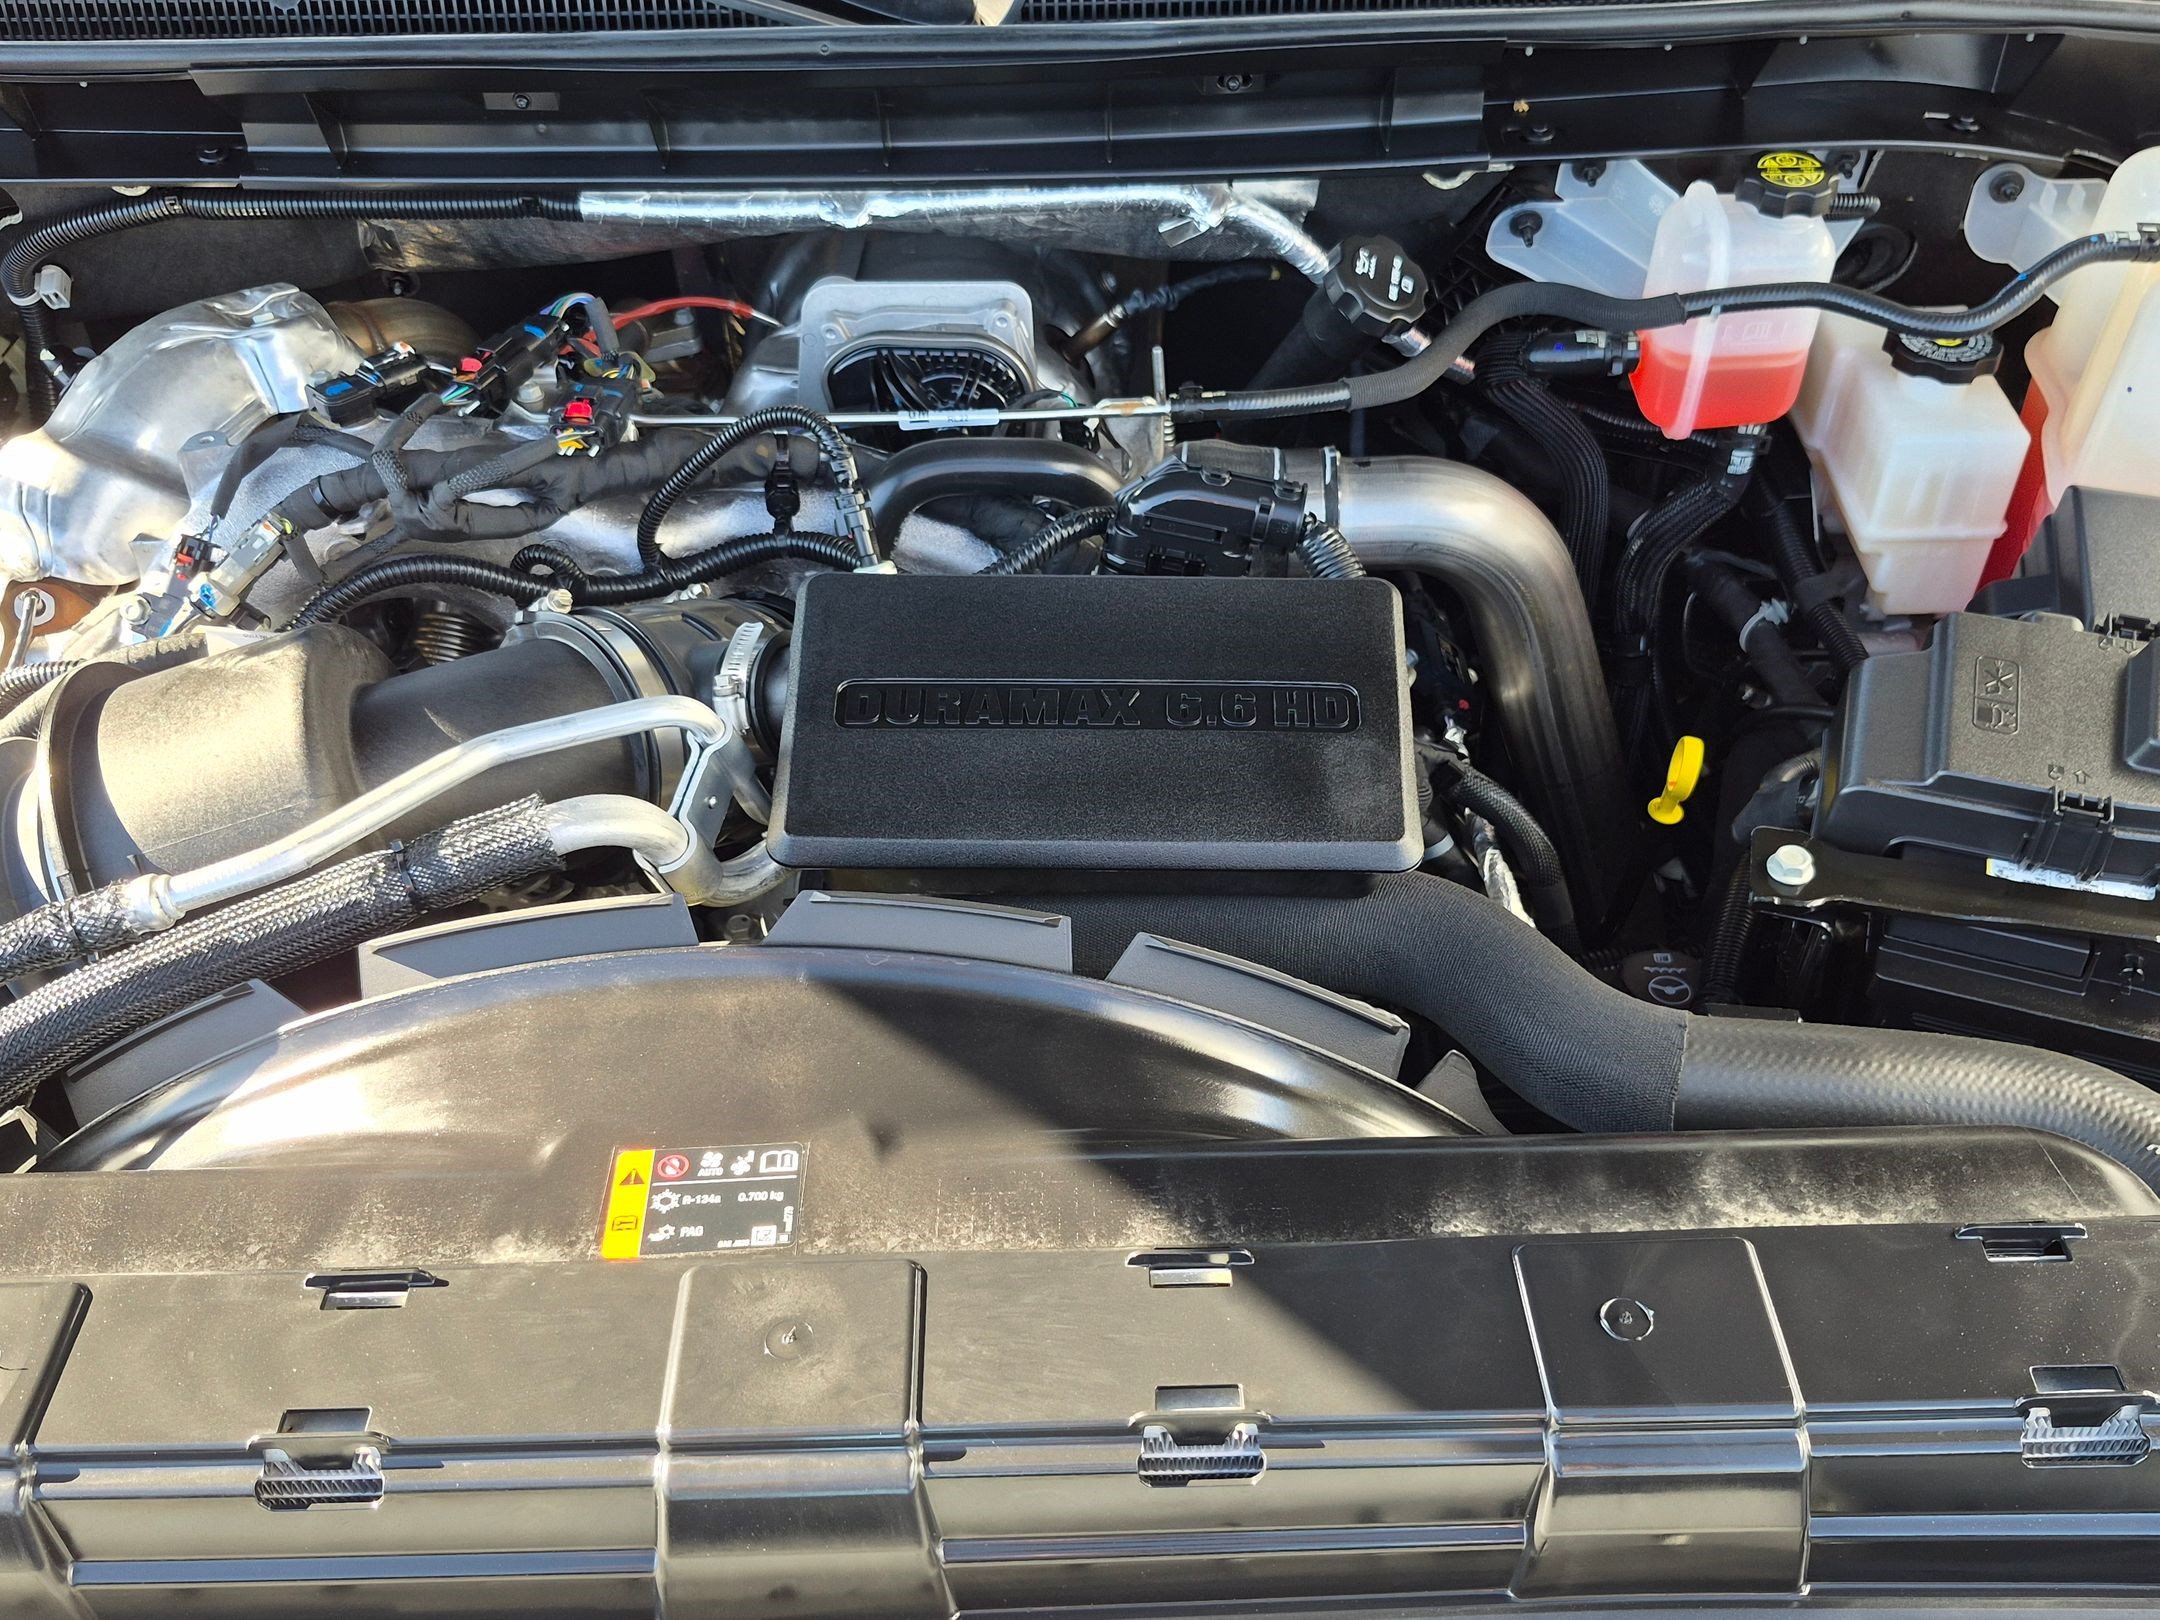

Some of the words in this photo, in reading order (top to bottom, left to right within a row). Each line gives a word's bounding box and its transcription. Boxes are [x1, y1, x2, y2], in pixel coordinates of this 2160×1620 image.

[844, 687, 1141, 726] DURAMAX
[1166, 690, 1257, 727] 6.6
[1272, 690, 1350, 728] HD
[697, 1167, 724, 1177] AUTO
[682, 1193, 722, 1205] R-134a
[737, 1191, 768, 1202] 0.700
[769, 1190, 784, 1202] kg
[679, 1225, 704, 1238] PAG
